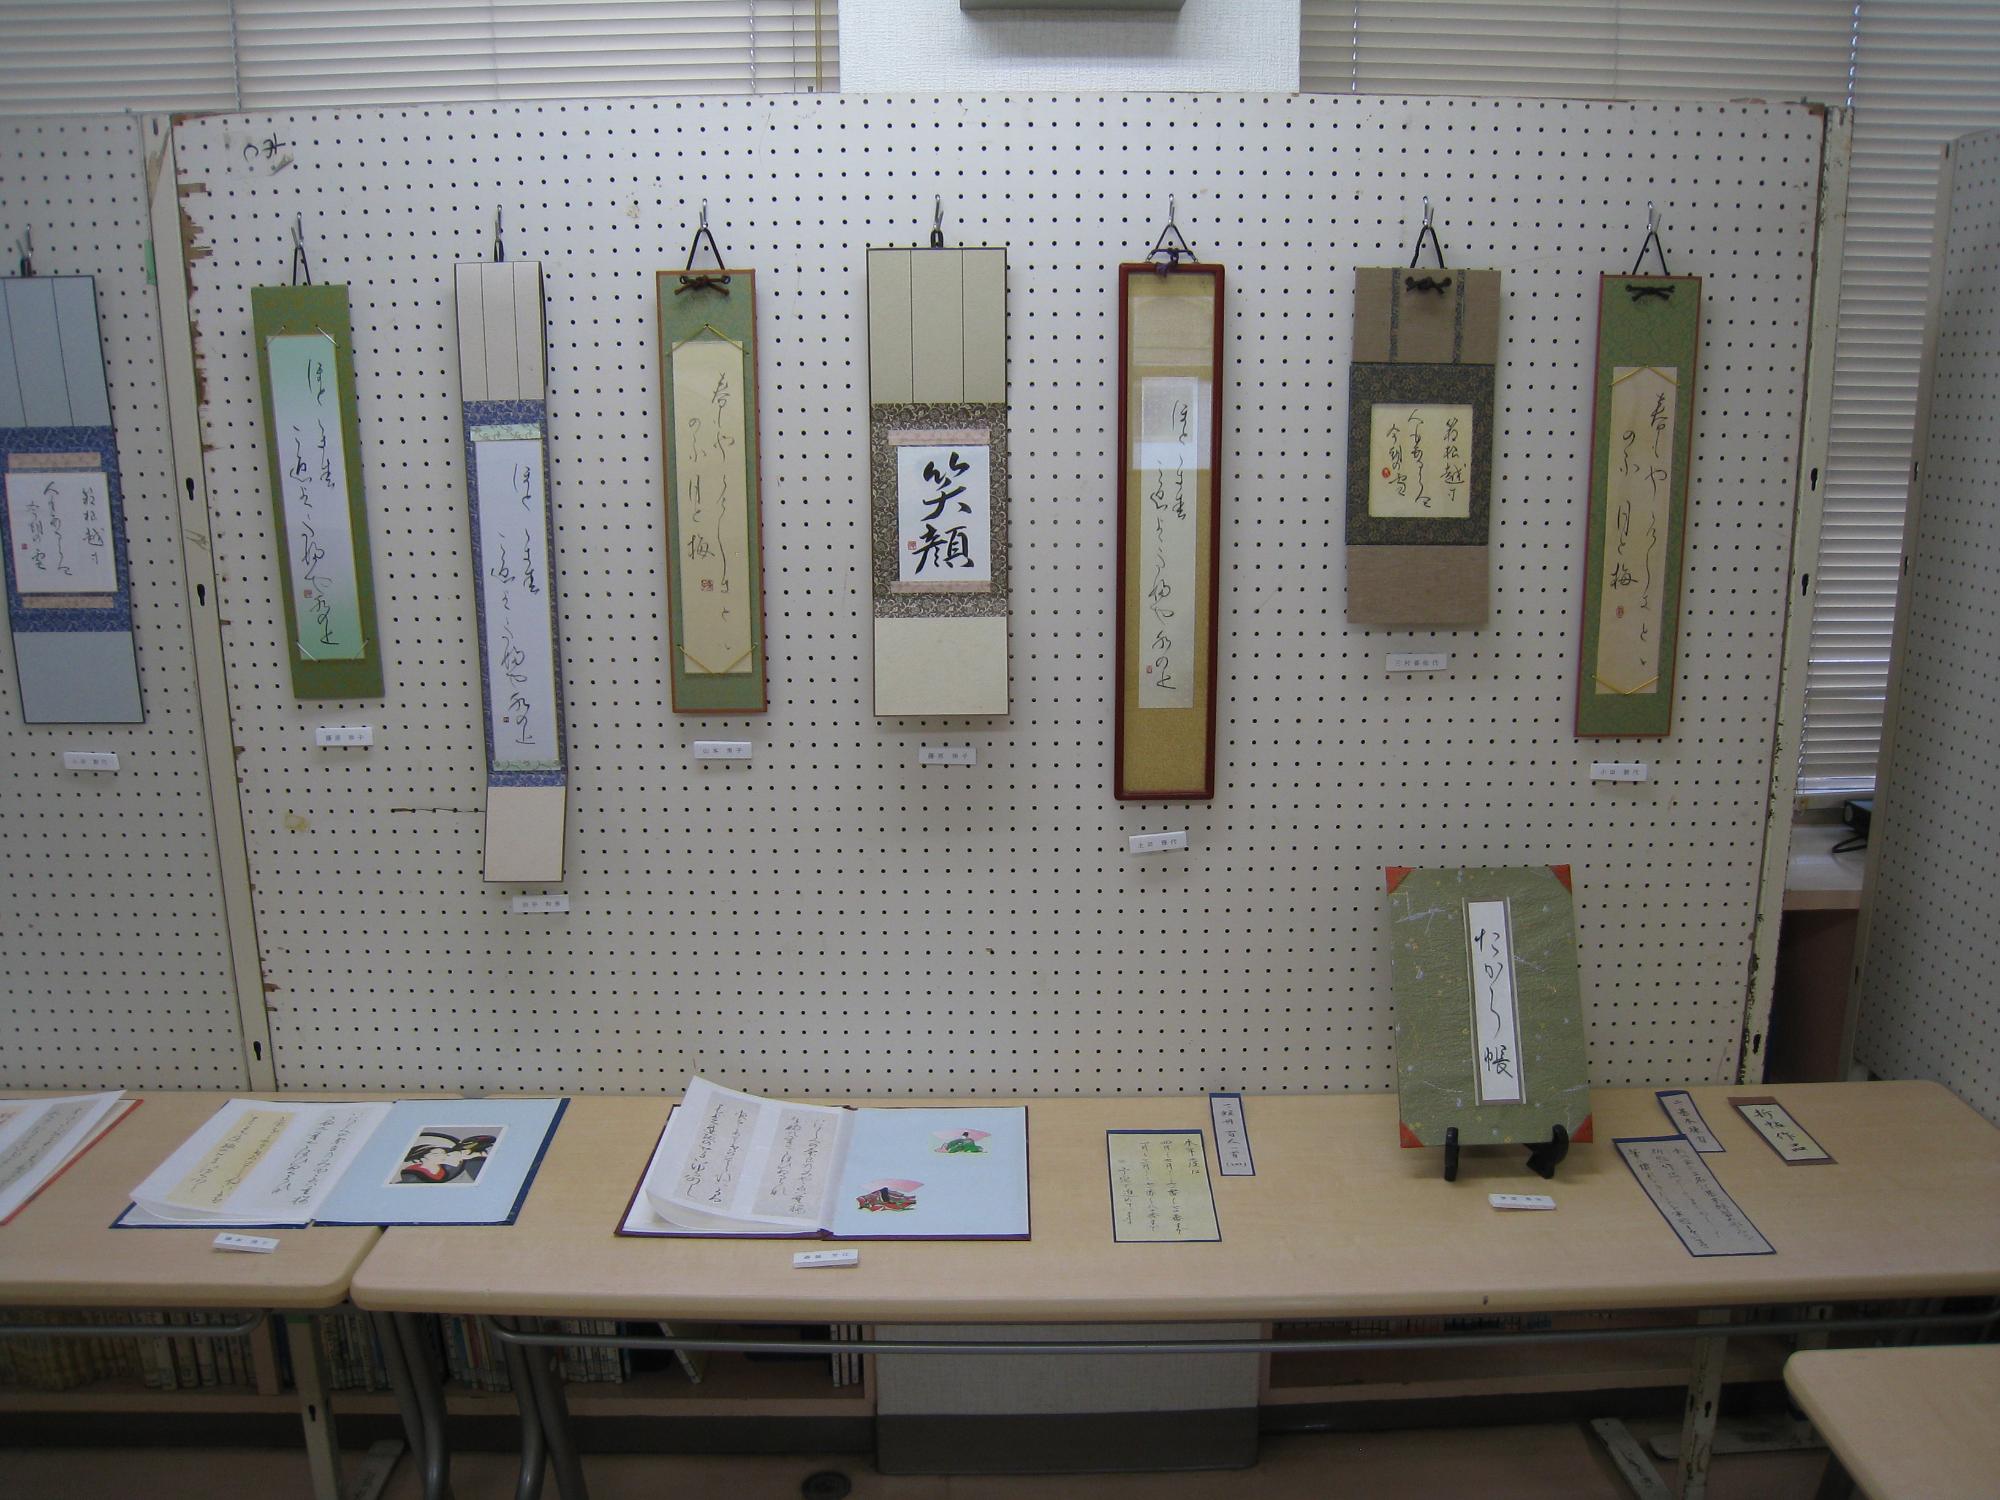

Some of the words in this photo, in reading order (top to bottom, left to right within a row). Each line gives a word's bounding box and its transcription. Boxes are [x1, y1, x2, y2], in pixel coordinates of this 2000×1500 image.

[911, 450, 976, 576] 笑顔
[1474, 927, 1514, 1080] たから帳
